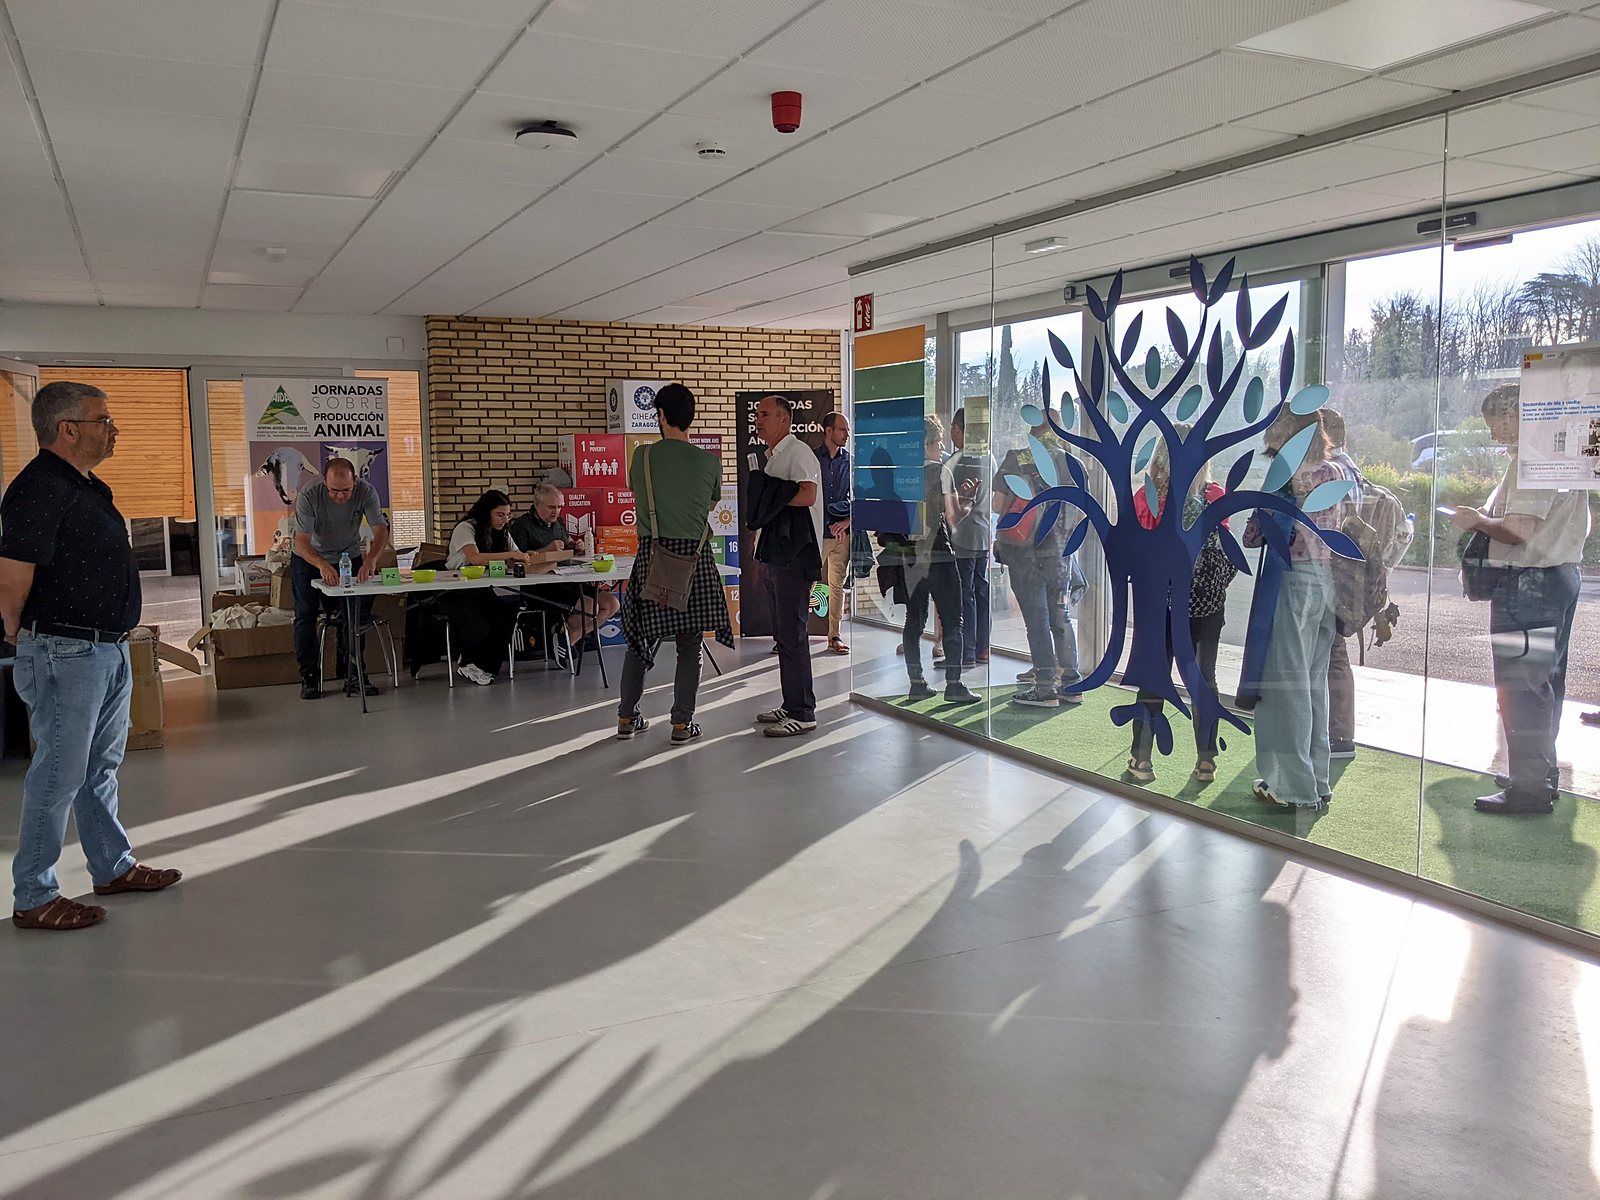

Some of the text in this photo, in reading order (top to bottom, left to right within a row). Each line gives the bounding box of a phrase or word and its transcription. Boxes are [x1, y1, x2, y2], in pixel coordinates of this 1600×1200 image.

[311, 385, 383, 396] JORNADAS
[311, 397, 383, 409] SOBRE
[313, 411, 384, 421] PRODUCCIÓN
[313, 424, 385, 437] ANIMAL
[580, 440, 586, 452] 1
[607, 491, 614, 504] 5
[728, 541, 738, 553] 16
[730, 590, 740, 601] 12
